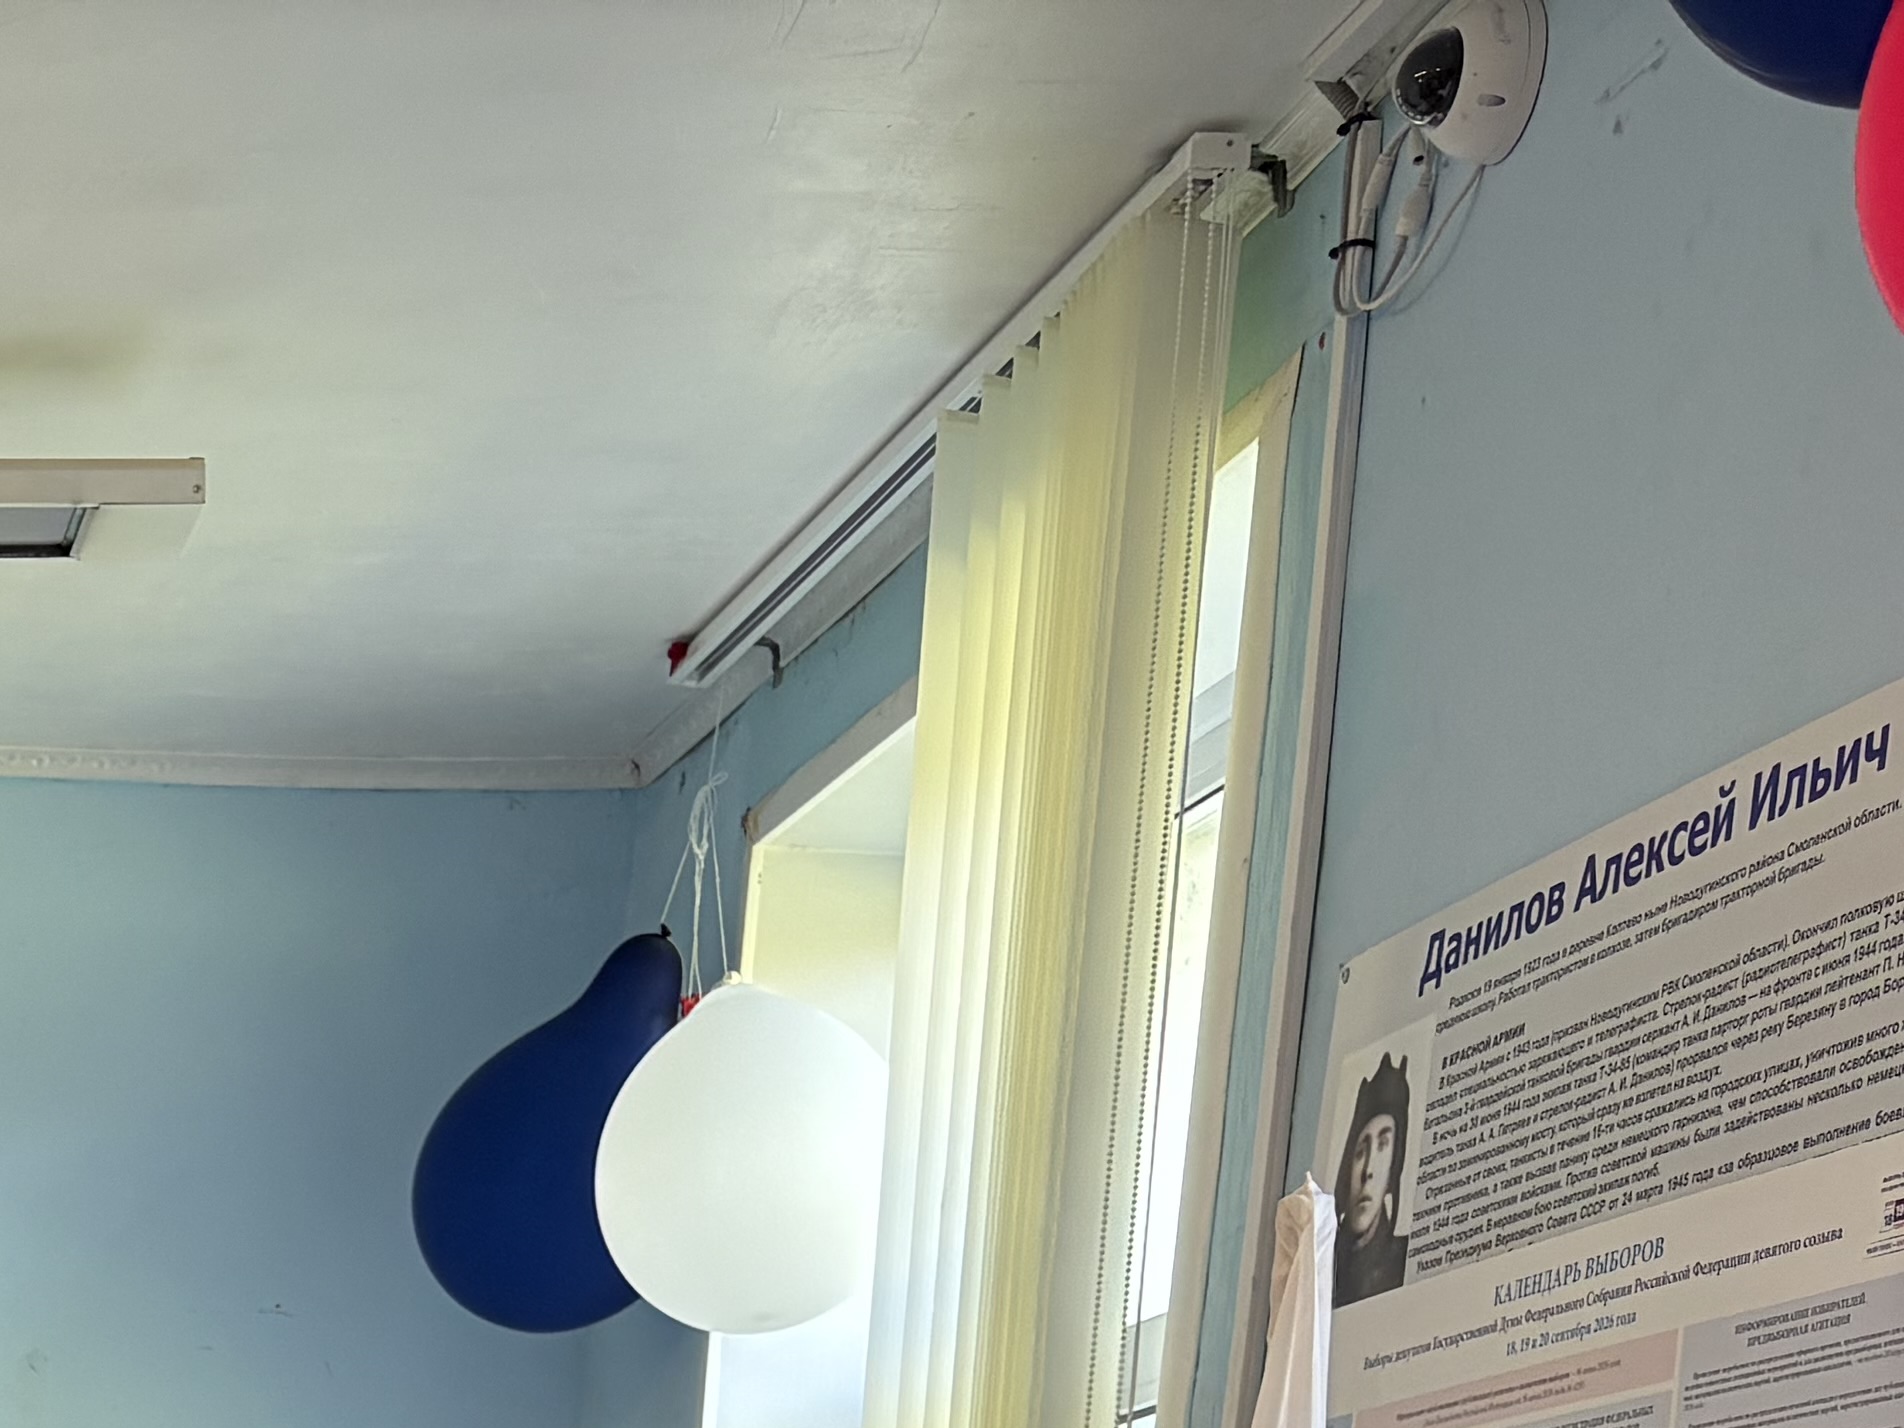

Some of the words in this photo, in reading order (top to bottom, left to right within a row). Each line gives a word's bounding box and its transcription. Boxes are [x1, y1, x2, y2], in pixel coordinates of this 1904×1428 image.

[1854, 799, 1902, 828] области.
[1419, 880, 1564, 997] Данилов
[1574, 779, 1739, 913] Алексей
[1747, 723, 1891, 830] Ильич
[1792, 917, 1838, 944] Окончил
[1840, 894, 1894, 925] полковую
[1854, 940, 1877, 962] 1944
[1879, 934, 1904, 953] года
[1825, 964, 1881, 995] лейтенант
[1760, 1021, 1784, 1043] реку
[1787, 1002, 1837, 1029] Березину
[1848, 986, 1880, 1006] город
[1805, 1035, 1864, 1068] уничтожив
[1866, 1022, 1899, 1043] много
[1750, 1066, 1836, 1104] способствовали
[1580, 1199, 1606, 1219] СССР
[1668, 1172, 1689, 1191] 1945
[1738, 1141, 1799, 1170] образцовое
[1803, 1118, 1871, 1149] выполнение
[1494, 1262, 1581, 1306] КАЛЕНДАРЬ
[1584, 1237, 1664, 1279] ВЫБОРОВ
[1634, 1265, 1690, 1293] Российской
[1693, 1253, 1750, 1276] Федерации
[1753, 1239, 1801, 1263] девятого
[1803, 1228, 1842, 1248] созыва
[1594, 1315, 1614, 1333] 2026
